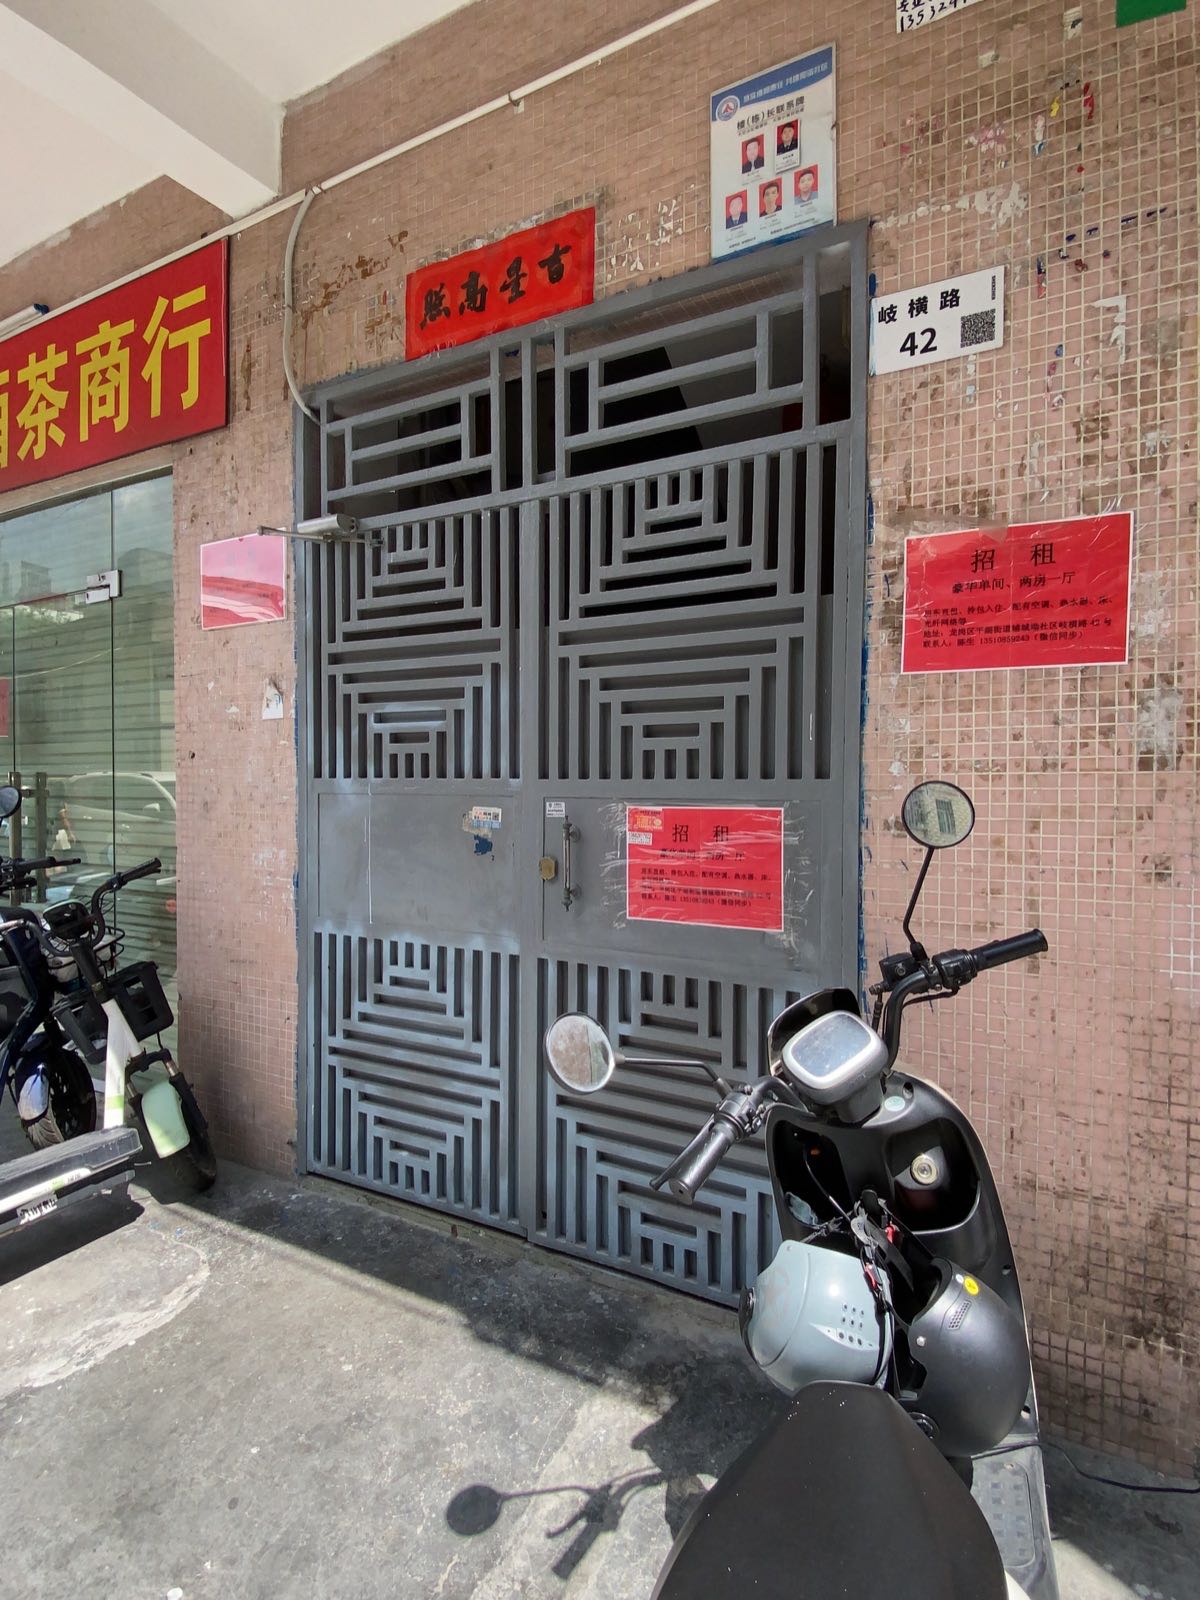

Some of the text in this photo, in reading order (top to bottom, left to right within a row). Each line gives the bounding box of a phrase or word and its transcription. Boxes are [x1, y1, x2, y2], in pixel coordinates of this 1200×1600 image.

[900, 0, 967, 32] 135324
[877, 288, 961, 324] 岐横路
[899, 327, 938, 357] 42
[0, 285, 211, 469] 茶商行
